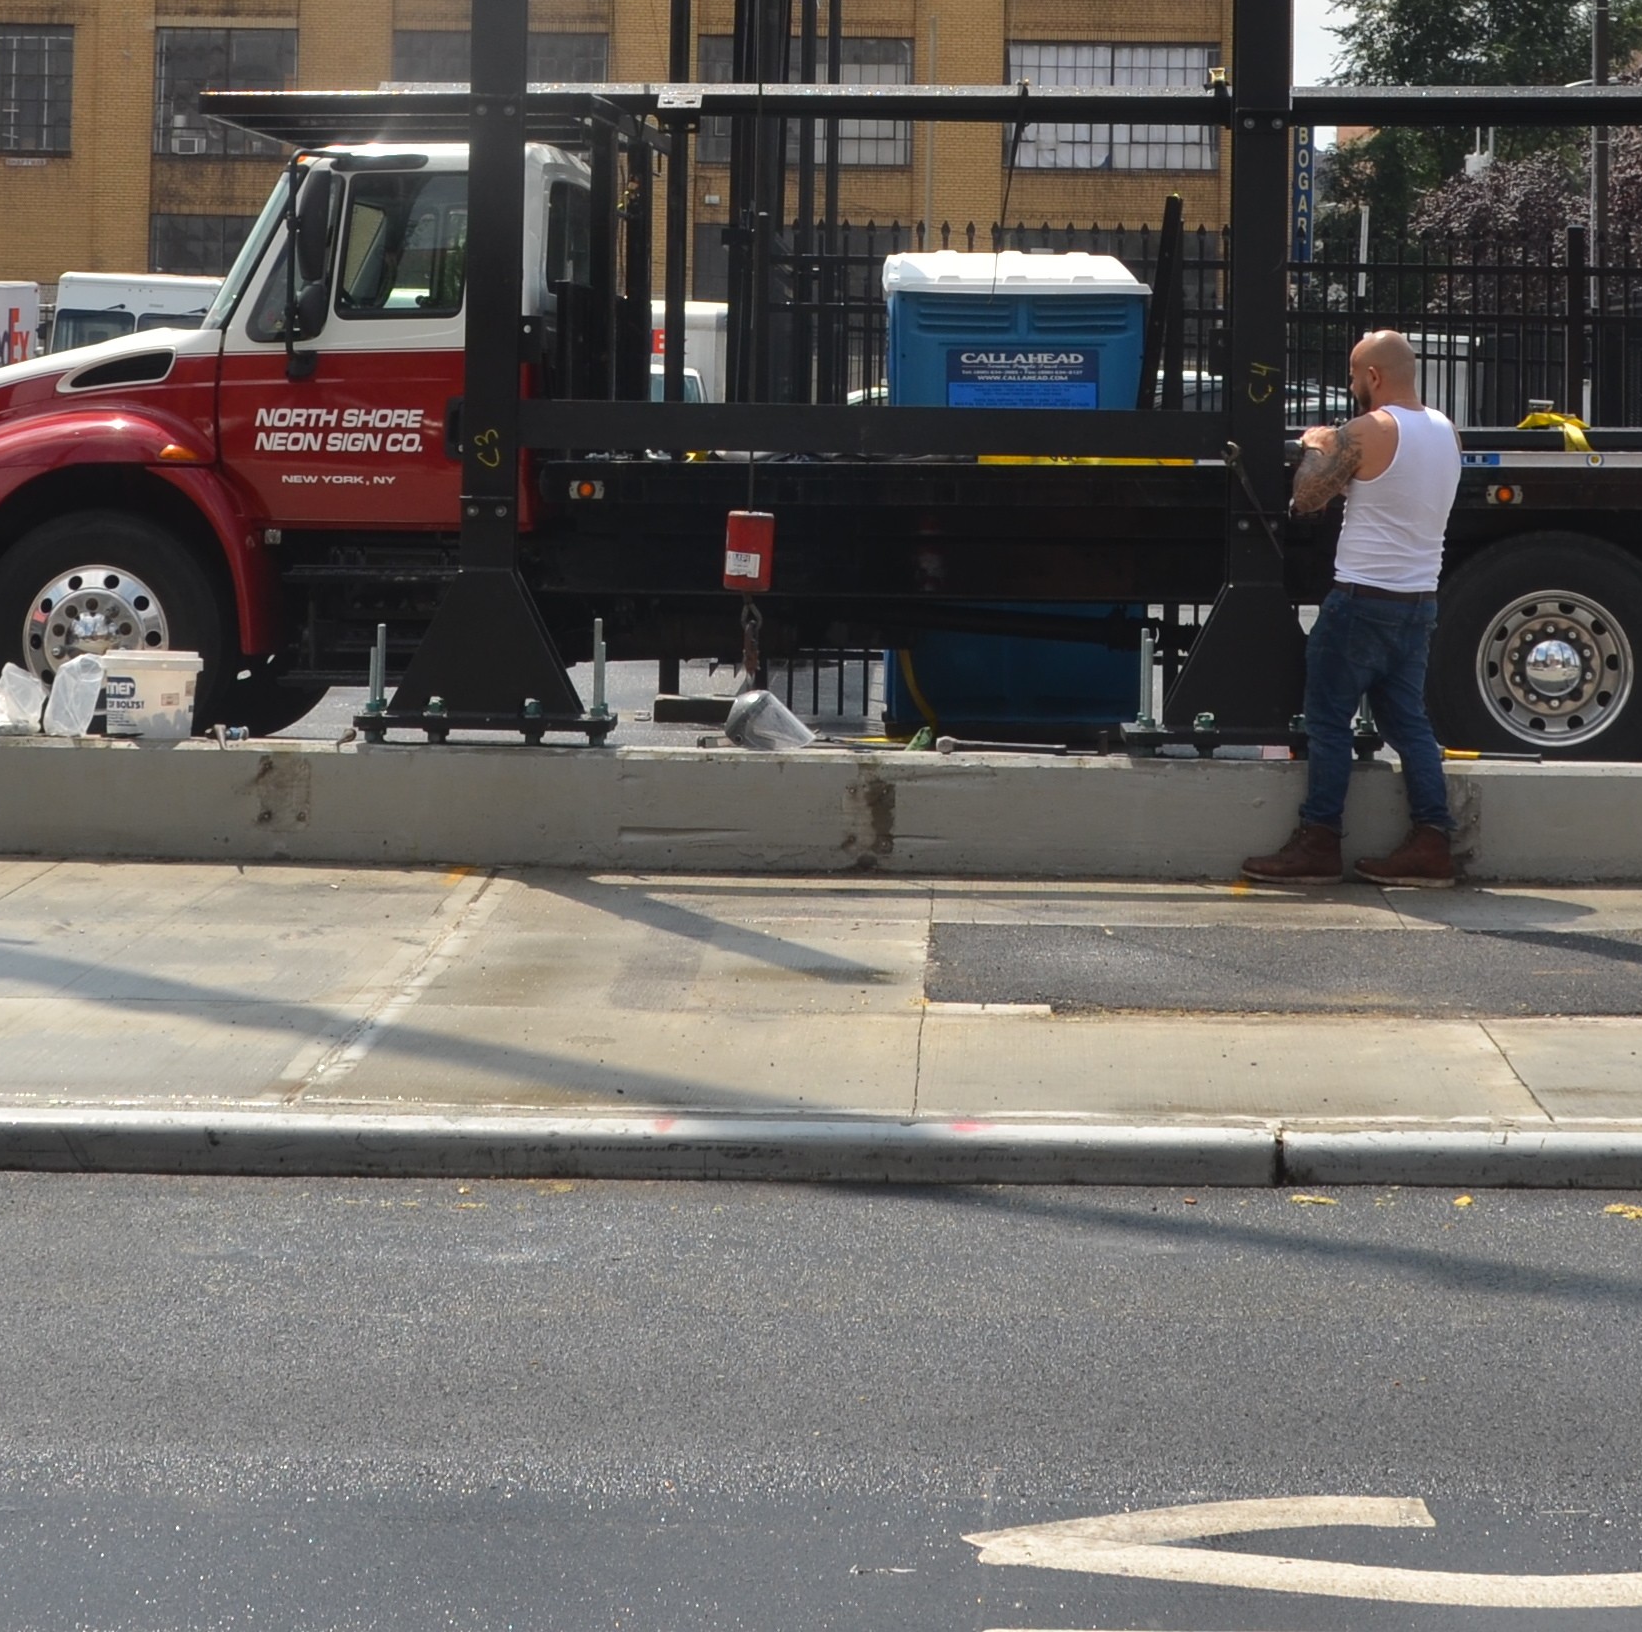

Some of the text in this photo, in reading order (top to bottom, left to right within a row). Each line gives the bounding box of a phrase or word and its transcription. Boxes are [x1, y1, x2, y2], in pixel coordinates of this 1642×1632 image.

[960, 352, 1085, 364] CALLAHEAD
[255, 408, 424, 428] NORTH SHORE
[255, 432, 423, 453] NEON SIGN CO.
[281, 475, 396, 486] NEW YORK, NY
